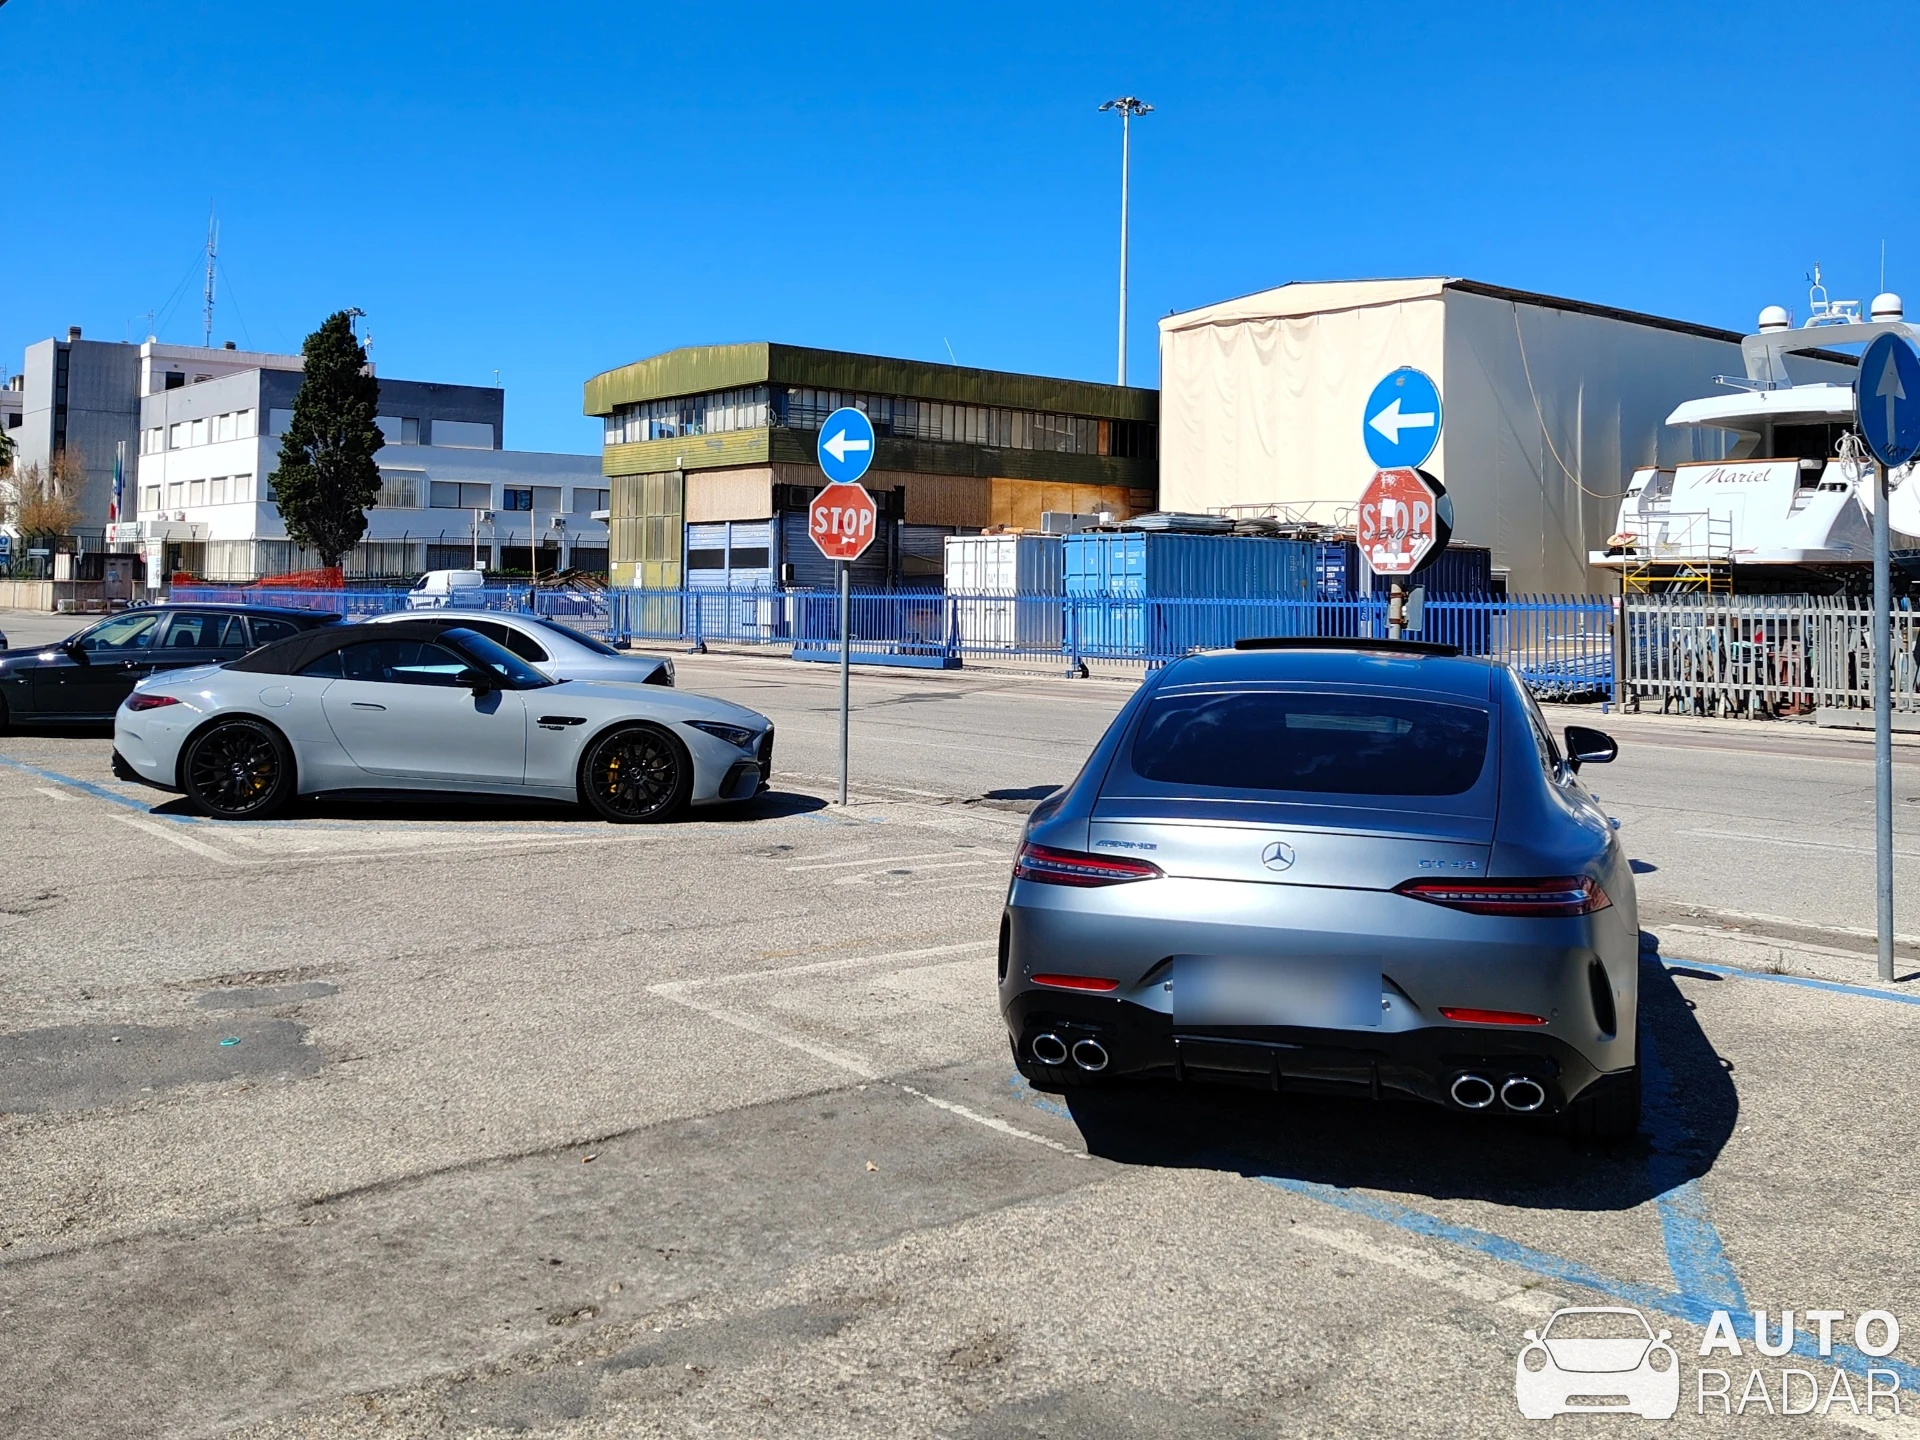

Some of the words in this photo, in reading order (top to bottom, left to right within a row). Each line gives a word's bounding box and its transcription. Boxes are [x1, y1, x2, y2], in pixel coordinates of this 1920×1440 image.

[1689, 467, 1772, 489] Mariel
[814, 506, 872, 536] STOP
[1418, 859, 1446, 869] GT
